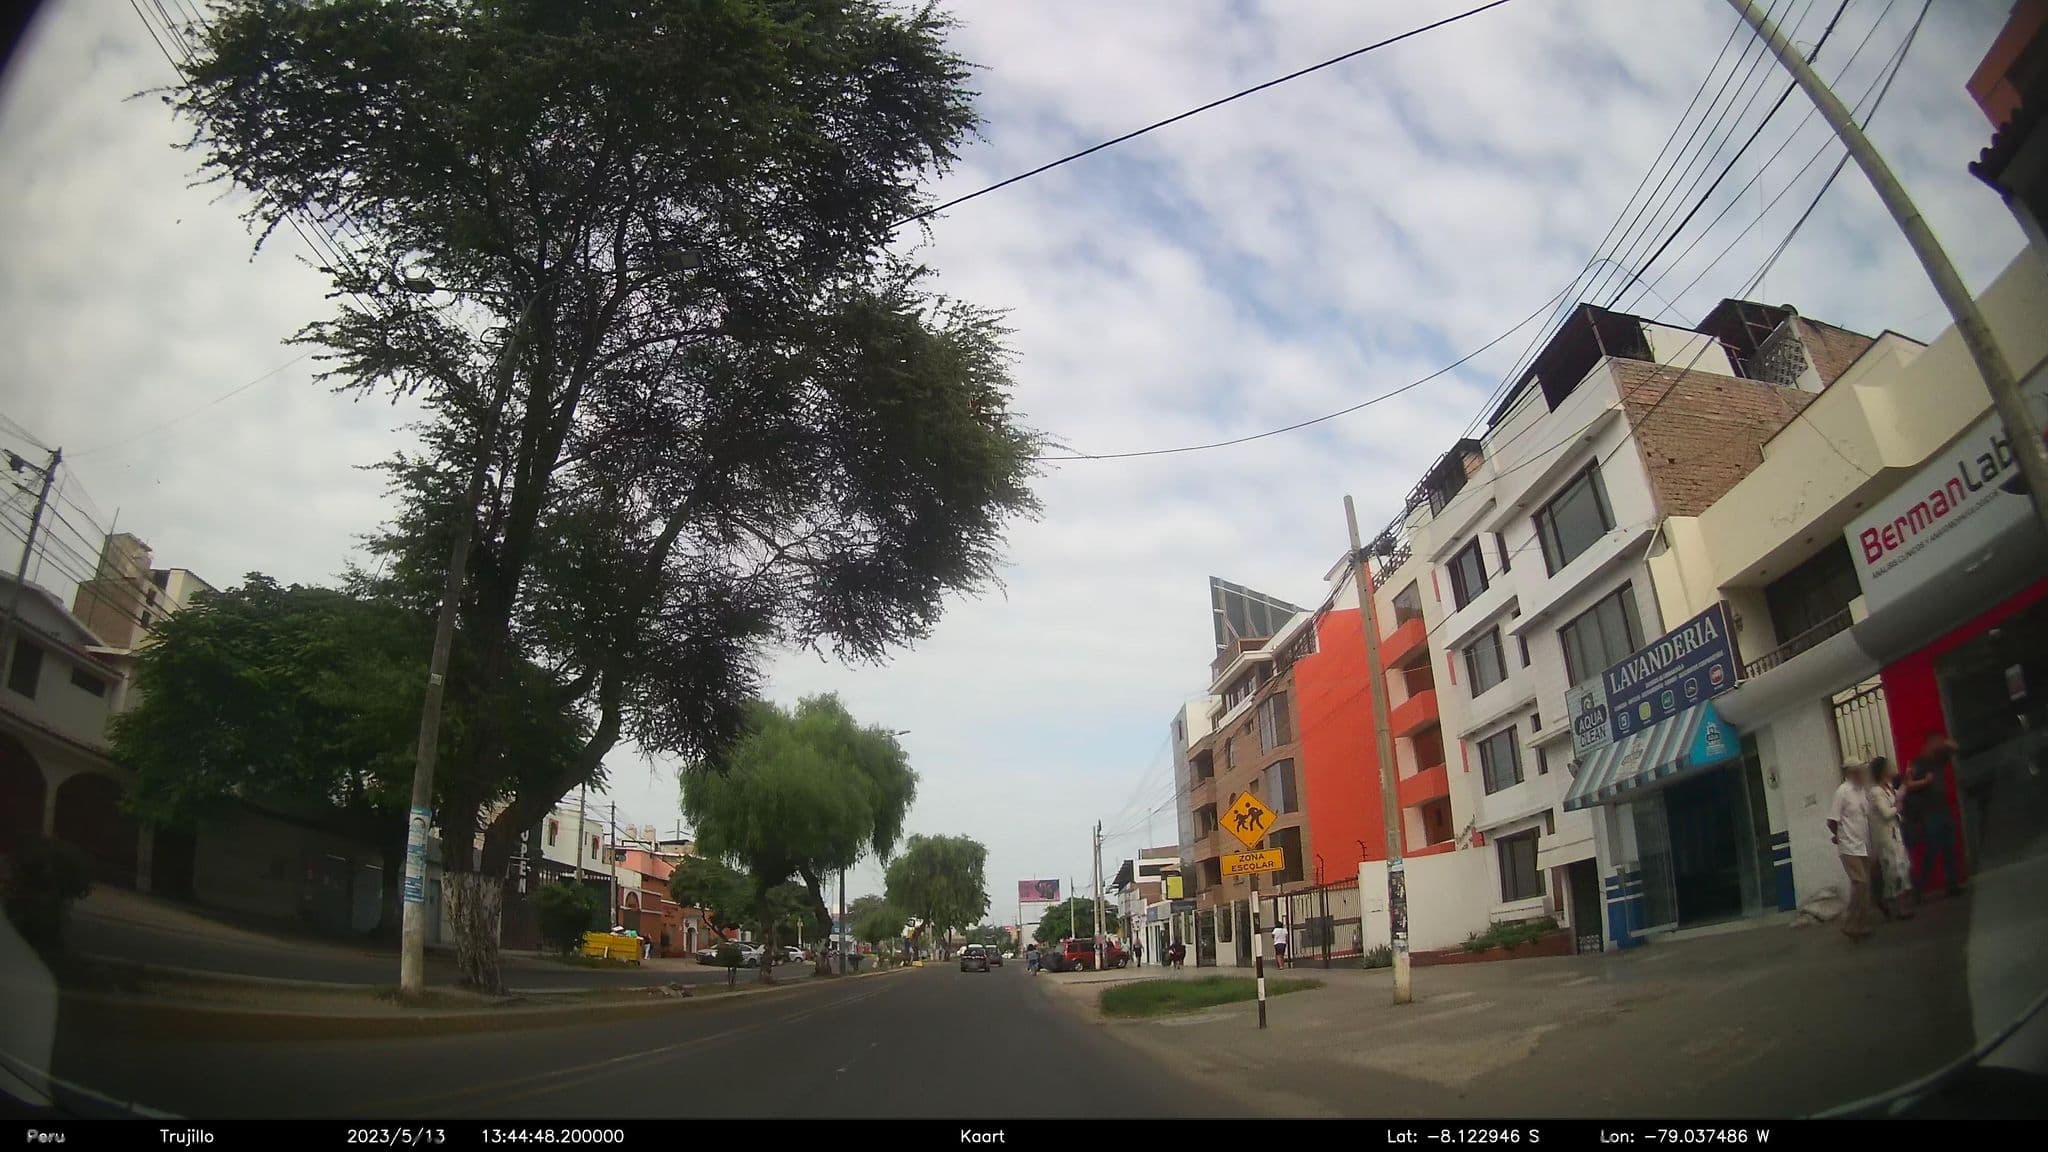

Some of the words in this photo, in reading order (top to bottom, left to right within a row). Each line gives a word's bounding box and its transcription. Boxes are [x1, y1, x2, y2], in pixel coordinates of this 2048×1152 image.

[1859, 435, 2014, 565] BermanLab
[1609, 616, 1719, 695] LAVANDERIA
[1578, 709, 1604, 732] AQUA
[1580, 725, 1607, 748] CLEAN
[1231, 860, 1274, 872] ESCOLAR
[1239, 853, 1264, 862] ZONA
